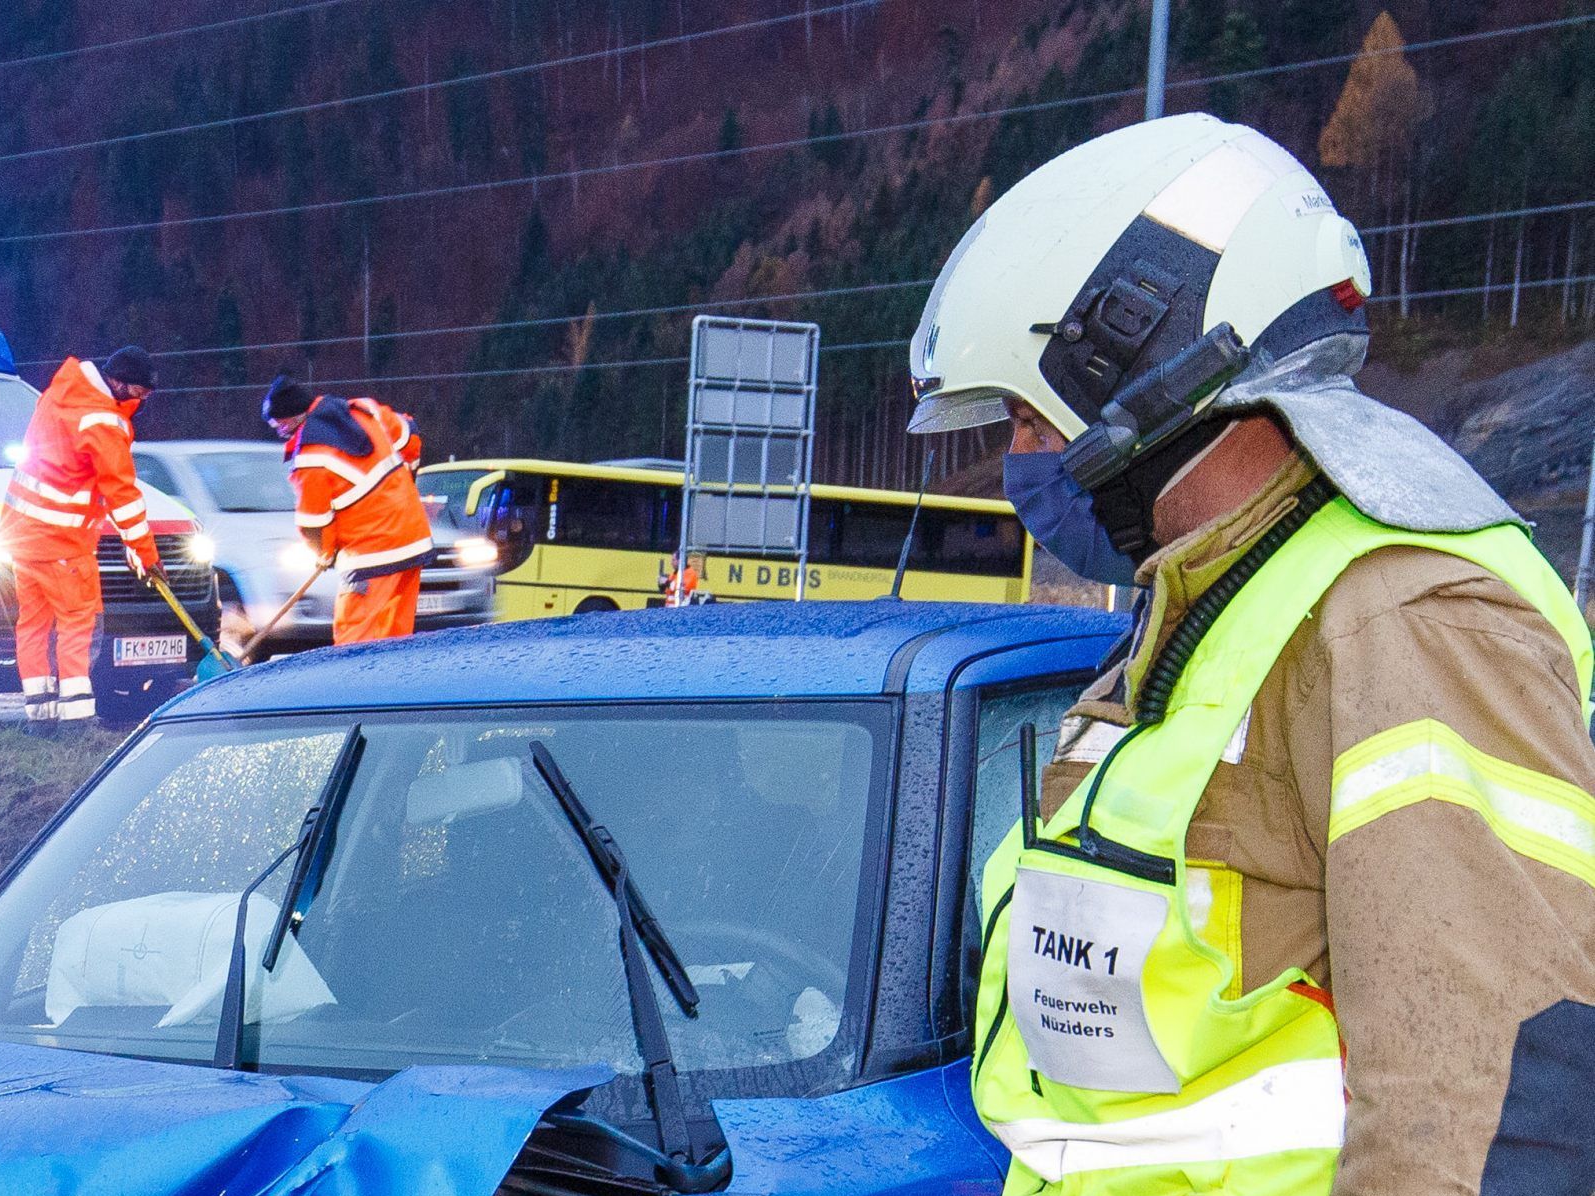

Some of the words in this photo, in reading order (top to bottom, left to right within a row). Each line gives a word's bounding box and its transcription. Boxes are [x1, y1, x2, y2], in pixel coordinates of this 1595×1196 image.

[125, 641, 140, 657] FK
[1032, 925, 1094, 970] TANK
[1104, 946, 1119, 976] 1
[1034, 988, 1118, 1016] Feuerwehr
[1040, 1013, 1115, 1038] Nüziders
